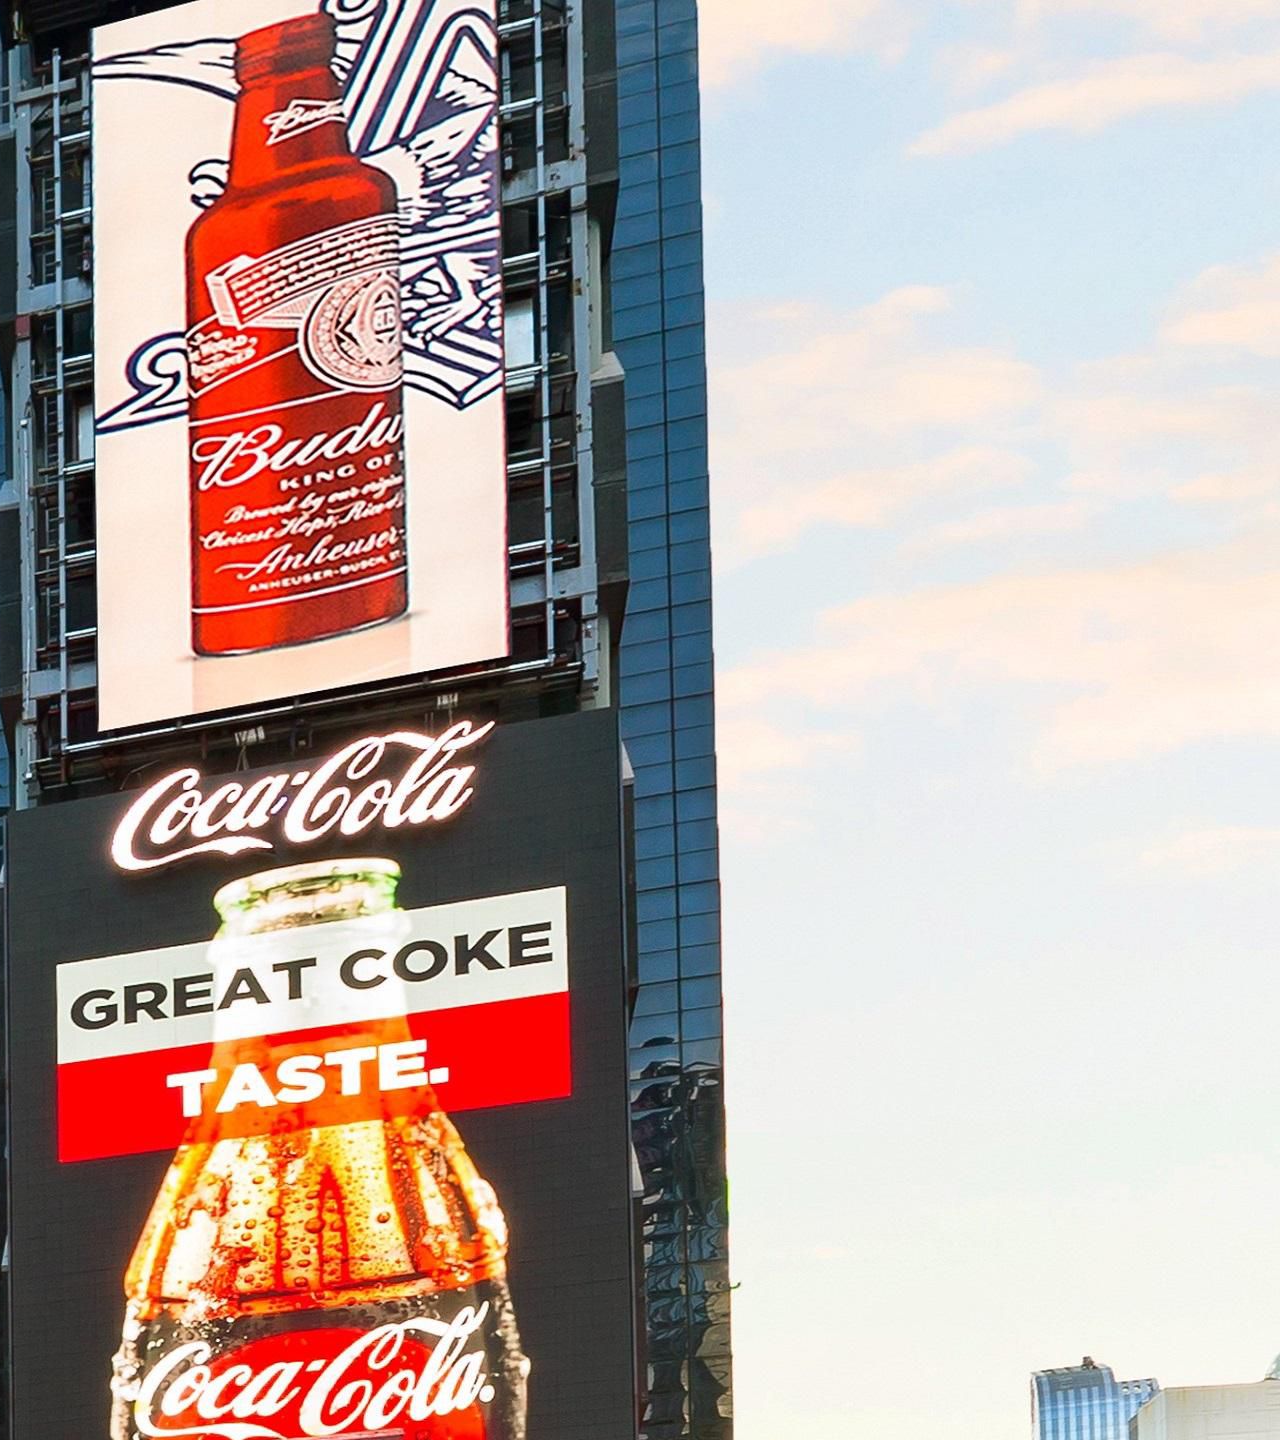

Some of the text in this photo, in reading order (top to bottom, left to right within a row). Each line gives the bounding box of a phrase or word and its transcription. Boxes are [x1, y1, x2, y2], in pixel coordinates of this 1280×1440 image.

[280, 464, 357, 491] KING
[110, 718, 496, 872] Coca-Cola
[68, 920, 554, 1031] GREAT COKE
[166, 1039, 450, 1119] TASTE.
